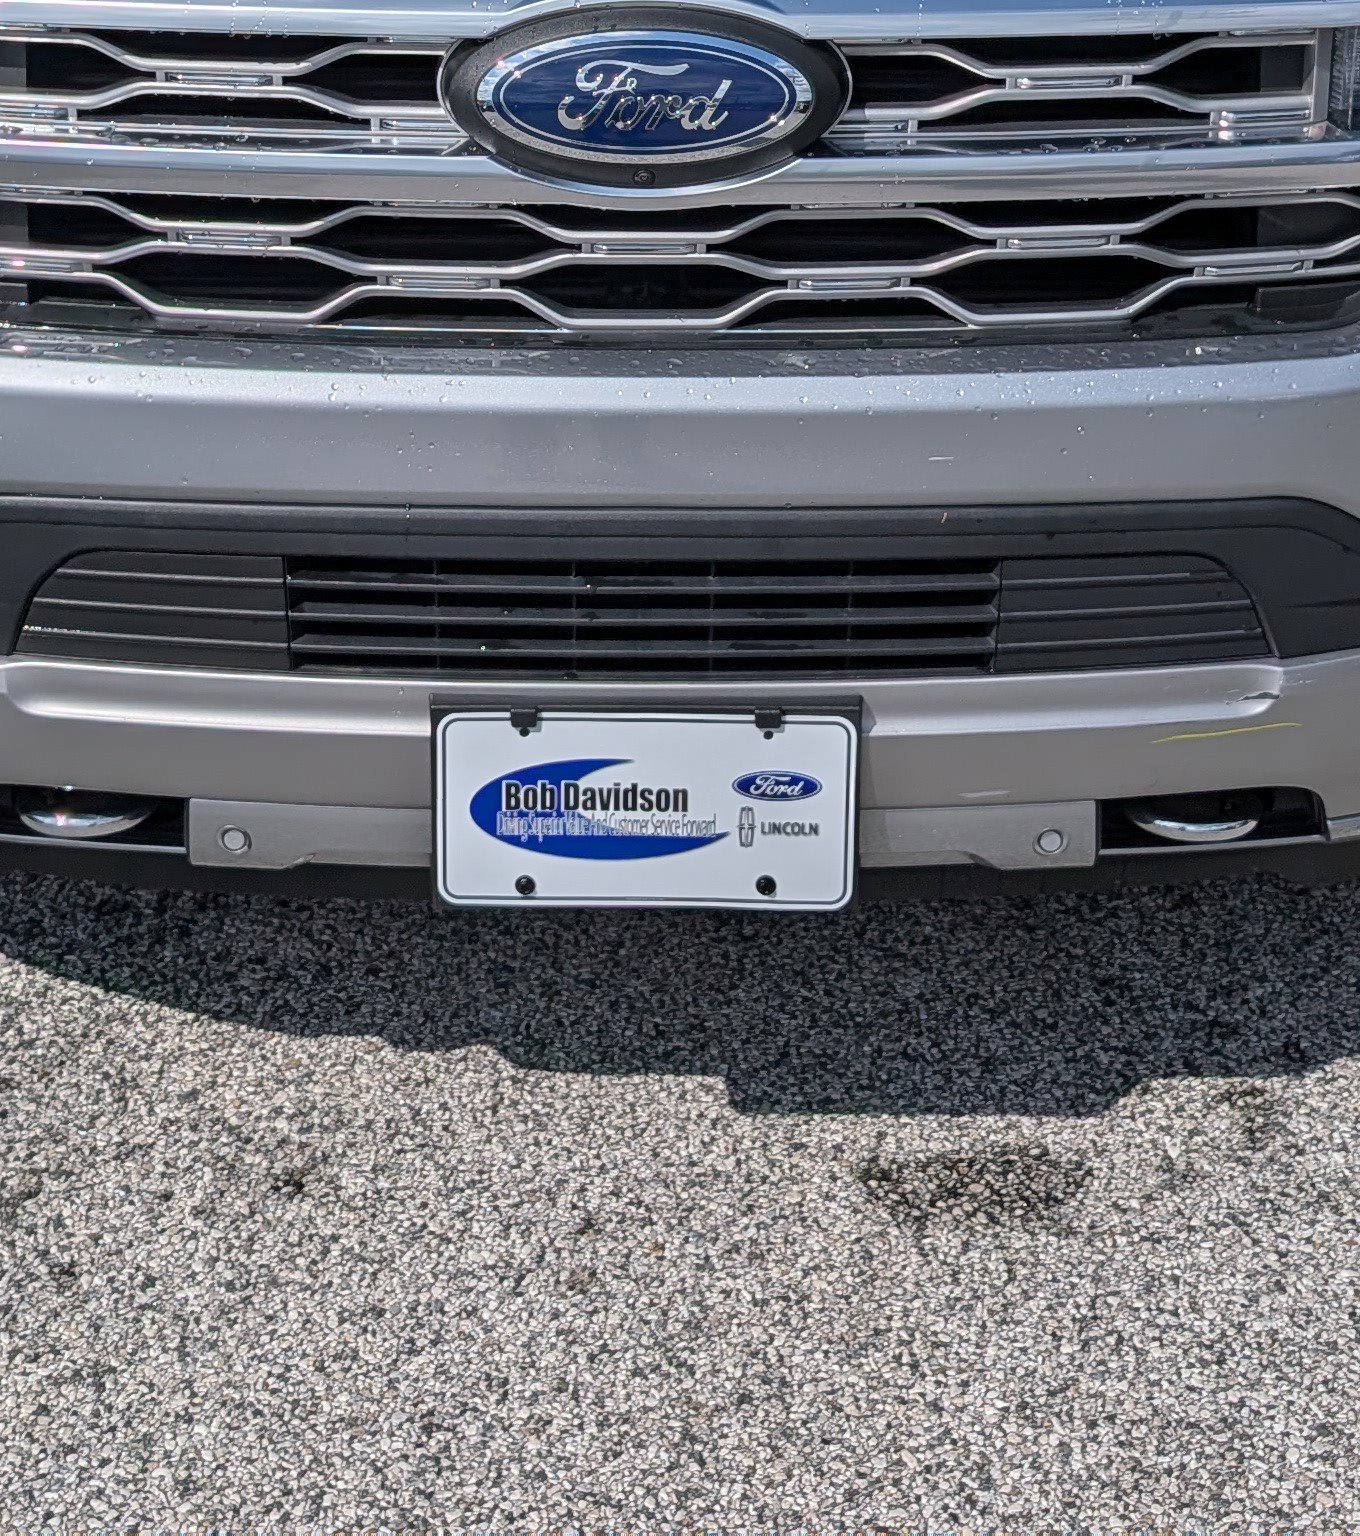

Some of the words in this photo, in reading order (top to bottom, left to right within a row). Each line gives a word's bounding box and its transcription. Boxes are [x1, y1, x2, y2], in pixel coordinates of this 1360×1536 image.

[557, 58, 733, 131] Ford
[503, 781, 556, 811] Bob
[562, 781, 689, 813] Davidson
[749, 774, 805, 796] Ford
[760, 821, 819, 836] LINCOLN
